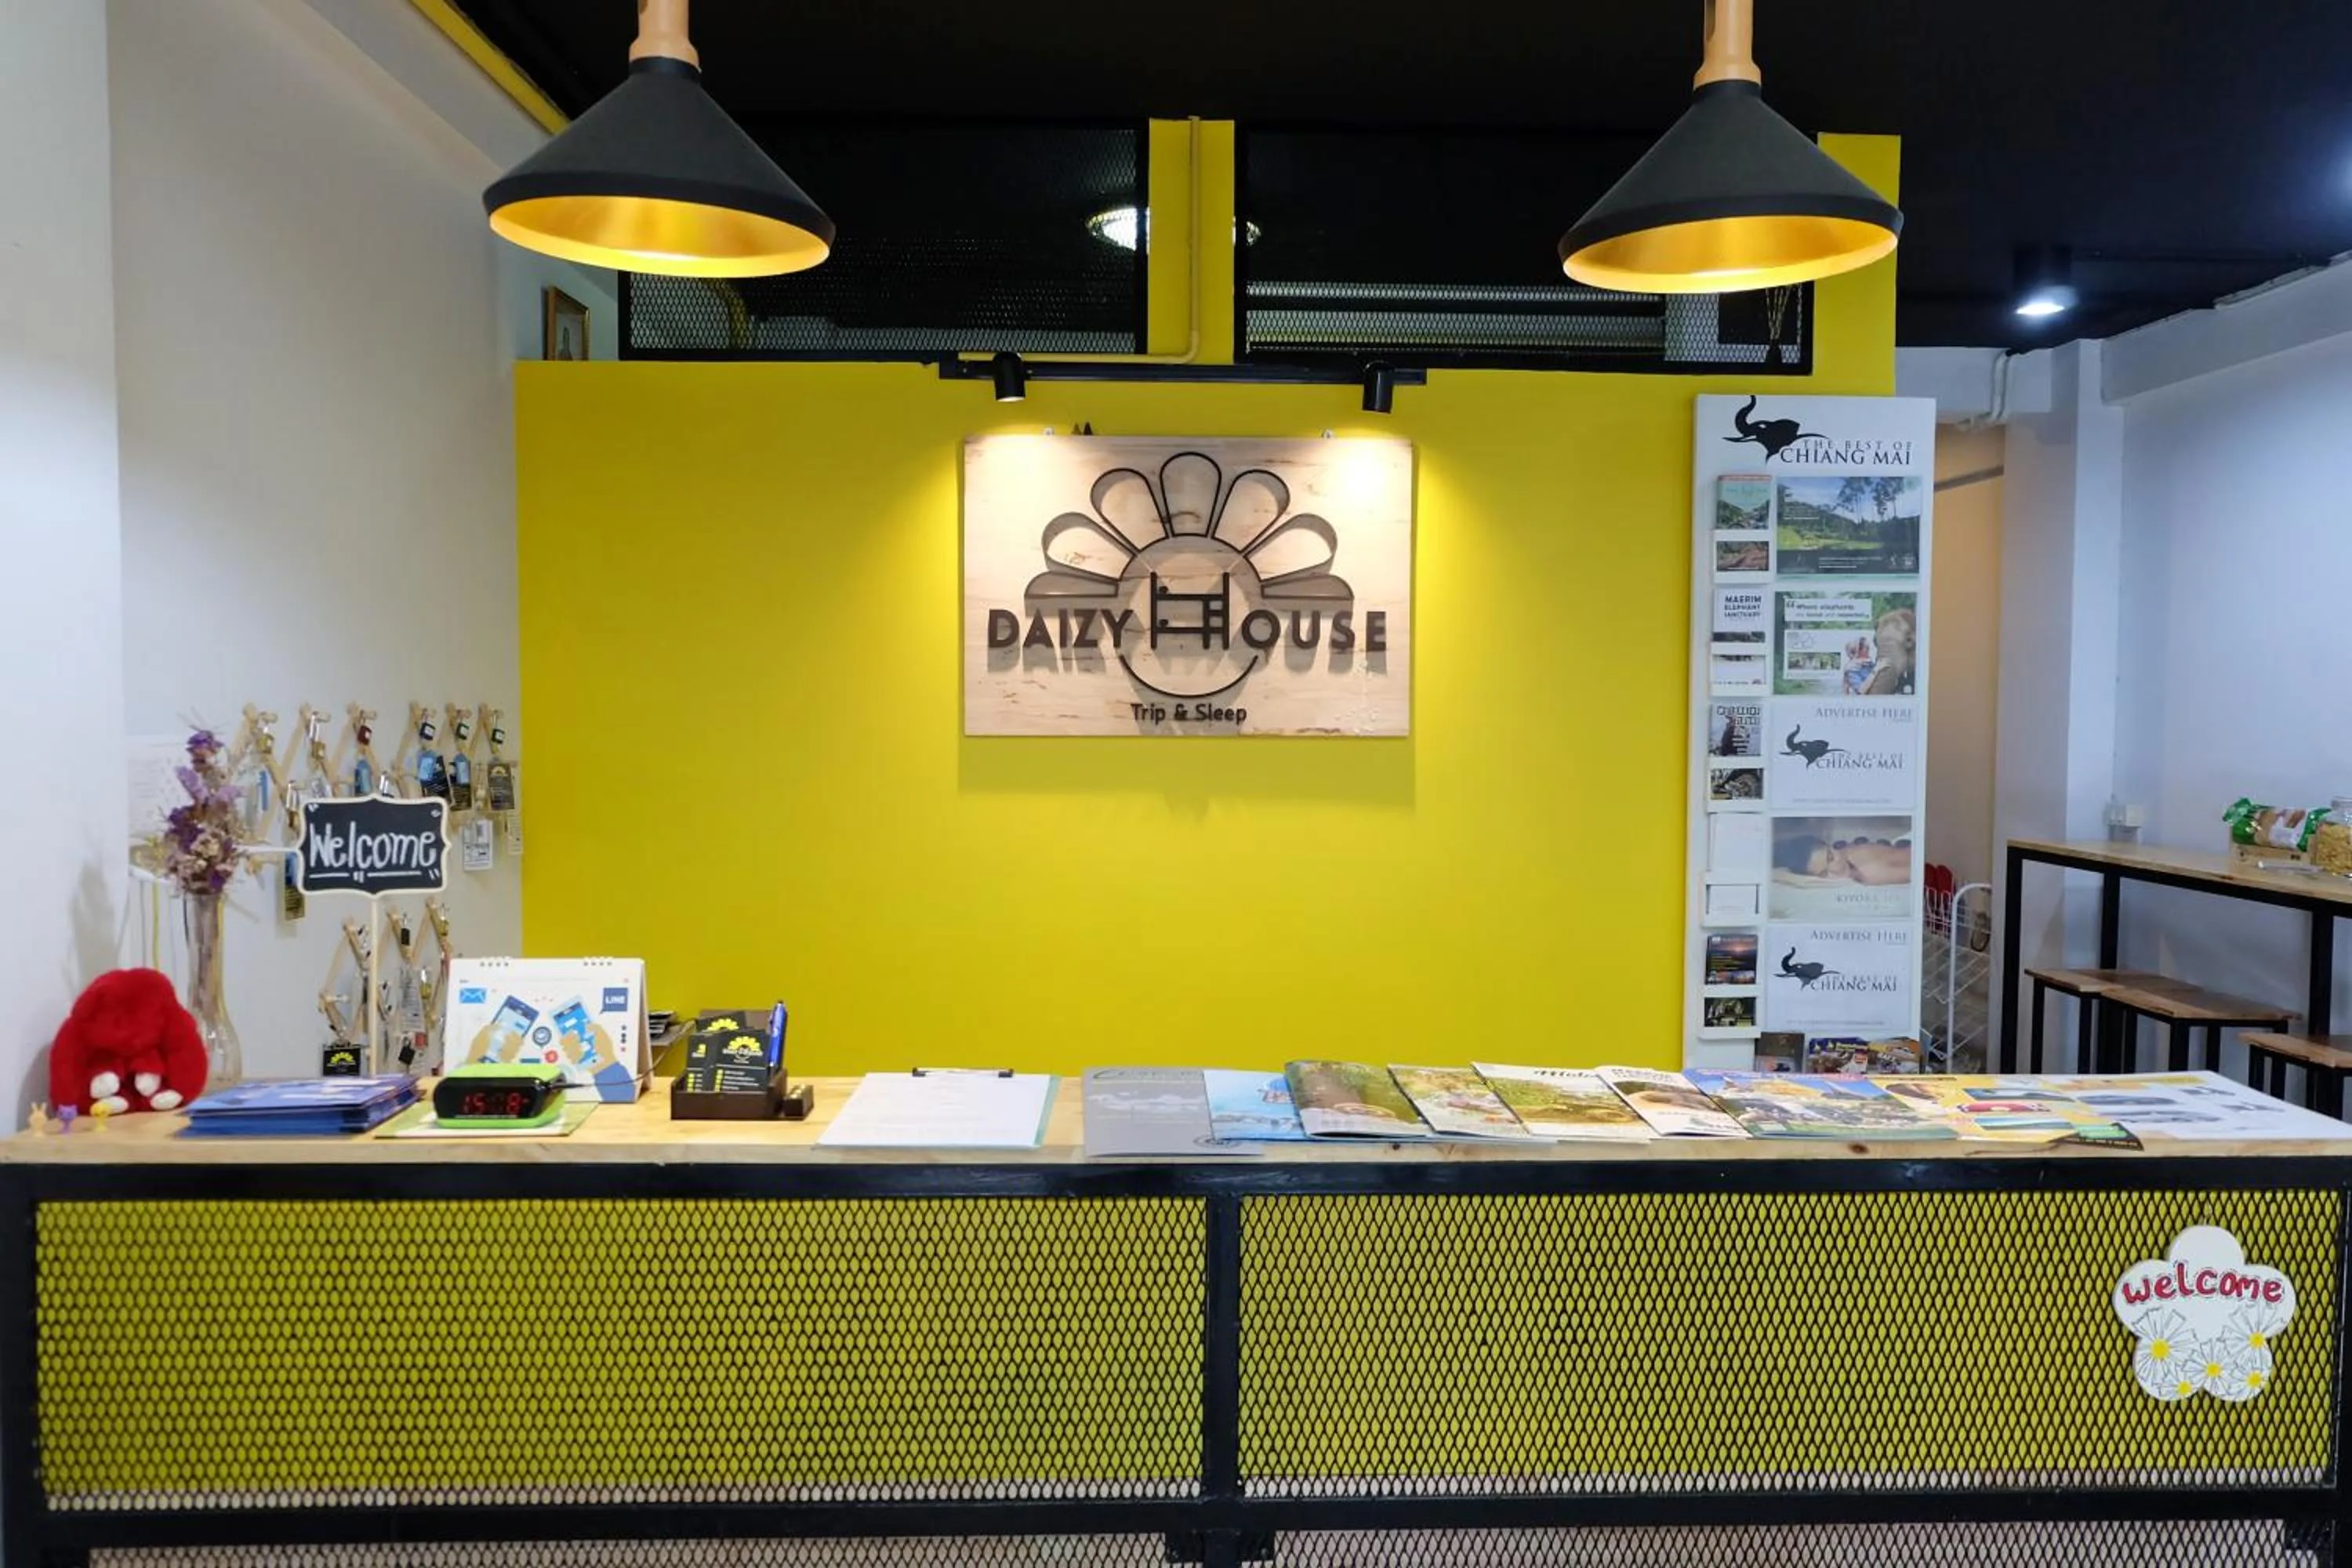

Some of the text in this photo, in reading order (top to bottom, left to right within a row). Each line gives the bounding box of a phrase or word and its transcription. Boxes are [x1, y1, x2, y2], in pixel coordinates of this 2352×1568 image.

[1804, 439, 1911, 451] THE BEST OF
[1780, 448, 1910, 465] CHIANG MAI
[988, 609, 1133, 648] DAIZY
[1131, 702, 1247, 724] Trip & Sleep
[1816, 758, 1904, 770] CHIANG MAI
[309, 821, 437, 869] Welcome
[1810, 980, 1897, 992] CHIANG MAI
[604, 995, 626, 1004] LINE
[2122, 1262, 2282, 1305] welcome
